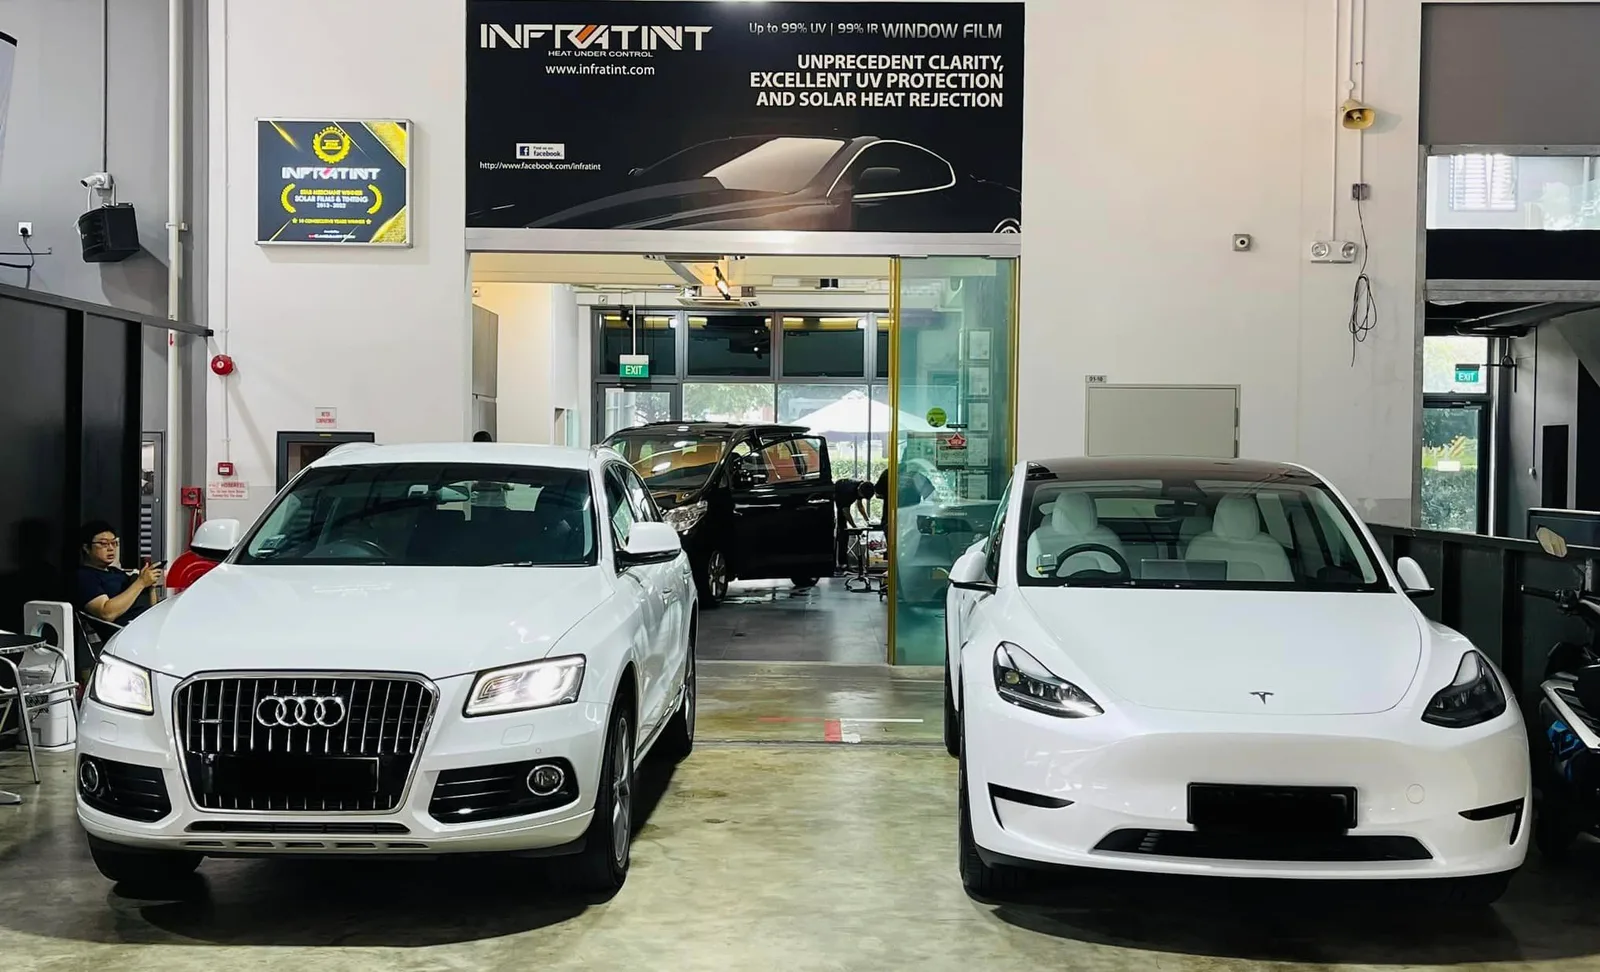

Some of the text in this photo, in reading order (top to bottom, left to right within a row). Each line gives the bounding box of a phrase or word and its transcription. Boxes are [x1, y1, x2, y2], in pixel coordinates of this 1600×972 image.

[480, 23, 713, 51] INFRATINT
[749, 22, 764, 35] Up
[767, 22, 779, 34] to
[781, 22, 808, 34] 99%
[810, 22, 827, 34] UV
[837, 22, 864, 34] 99%
[867, 23, 879, 34] IR
[882, 23, 959, 39] WINDOW
[963, 23, 1003, 39] FILM
[545, 63, 656, 76] www.infratint.com
[797, 54, 1004, 73] UNPRECEDENT CLARITY,
[750, 72, 1004, 89] EXCELLENT UV PROTECTION
[755, 91, 1003, 108] AND SOLAR HEAT REJECTION
[281, 166, 382, 180] INFRATINT
[479, 161, 601, 171] http://www.facebook.com/infratint
[625, 365, 643, 375] EXIT
[1458, 372, 1475, 381] EXIT
